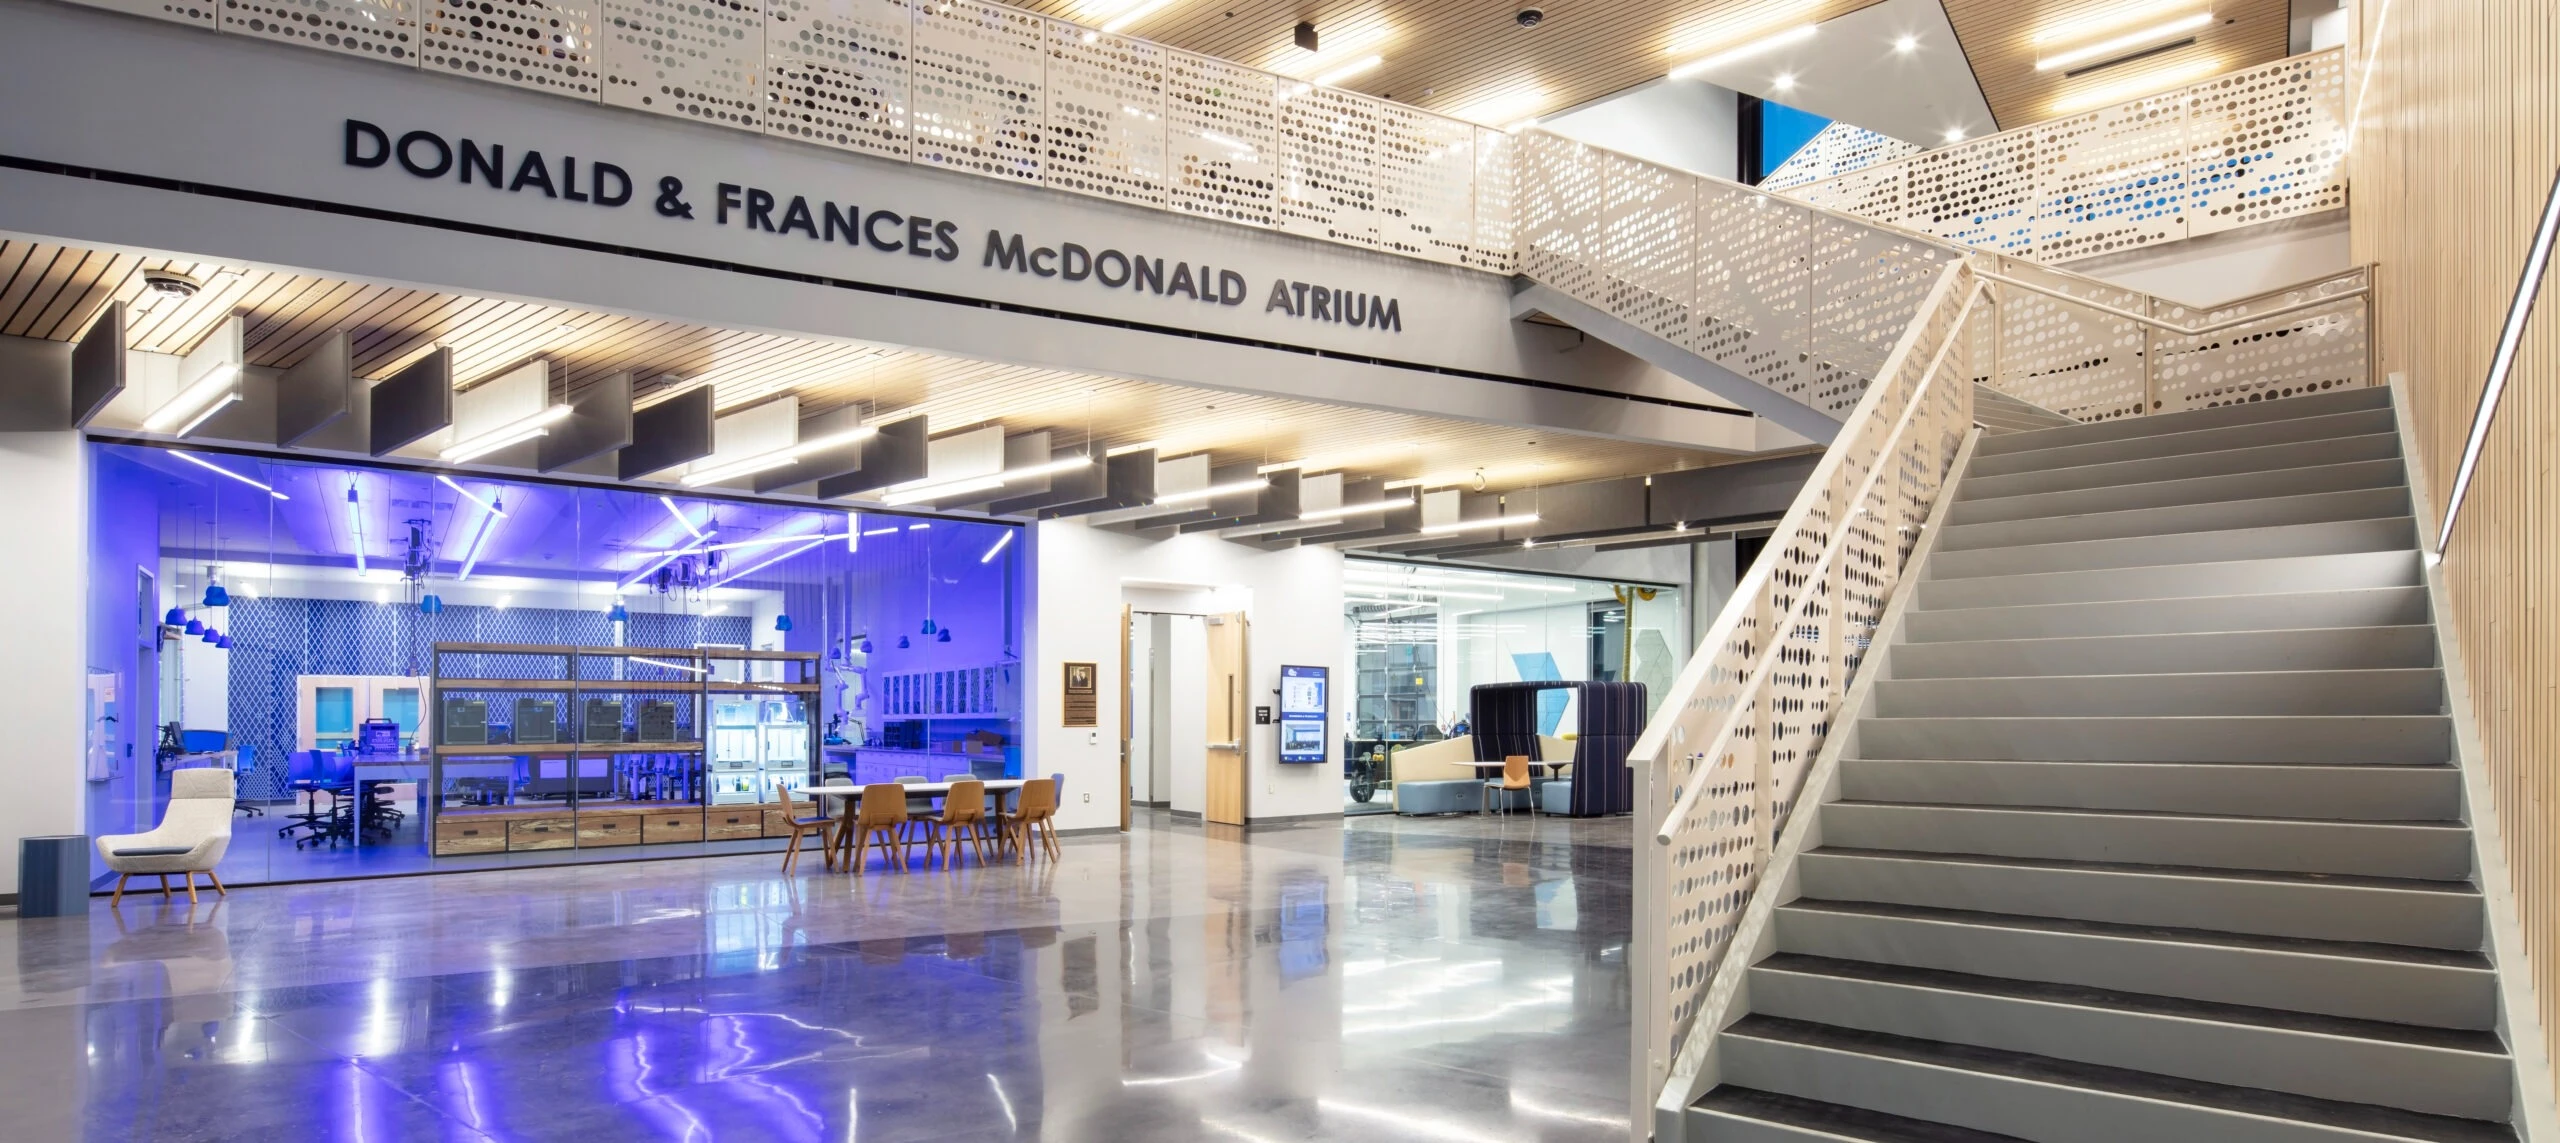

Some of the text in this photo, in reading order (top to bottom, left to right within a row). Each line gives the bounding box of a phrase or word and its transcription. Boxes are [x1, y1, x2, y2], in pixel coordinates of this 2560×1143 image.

[342, 118, 1402, 332] DONALD & FRANCES McDONALD ATRIUM
